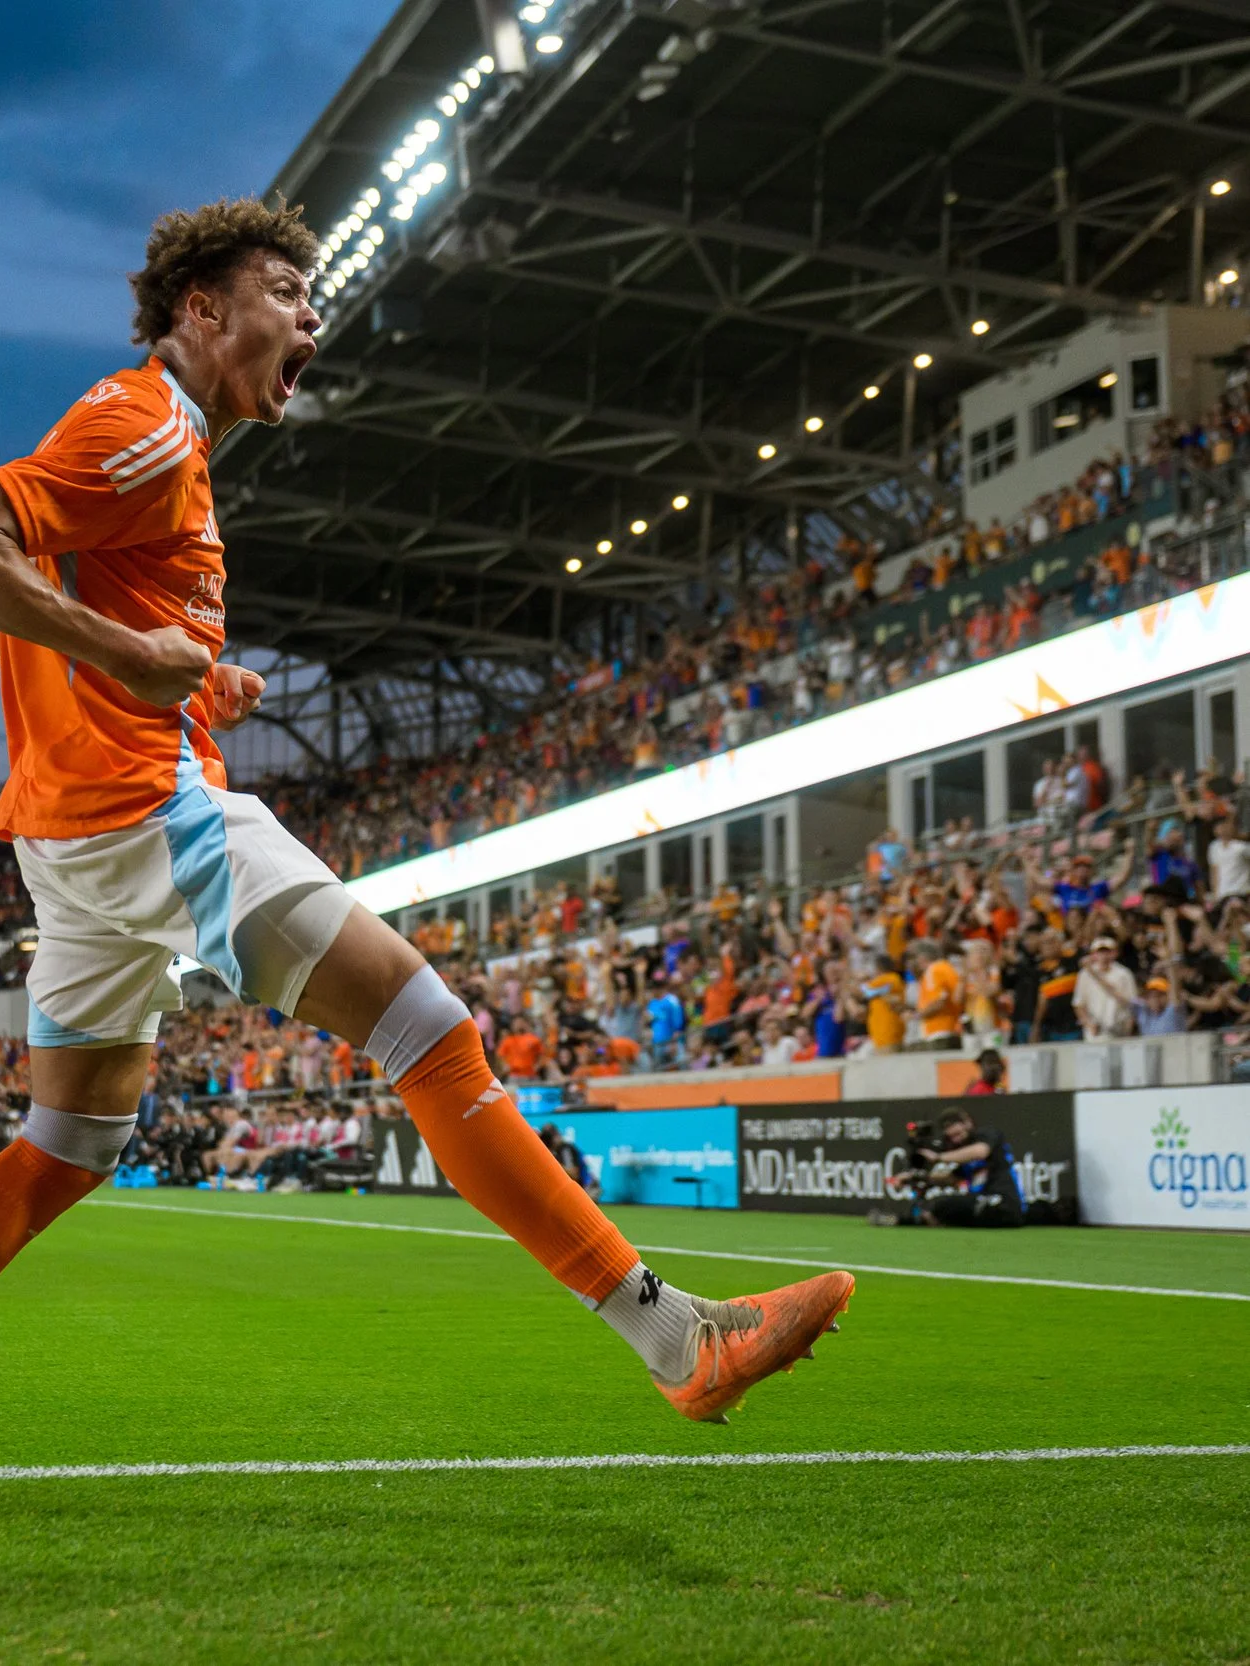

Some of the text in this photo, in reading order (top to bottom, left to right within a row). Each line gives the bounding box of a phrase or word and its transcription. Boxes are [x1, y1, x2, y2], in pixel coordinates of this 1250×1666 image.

[742, 1119, 766, 1140] THE
[825, 1118, 843, 1140] OF
[1149, 1139, 1247, 1208] cigna
